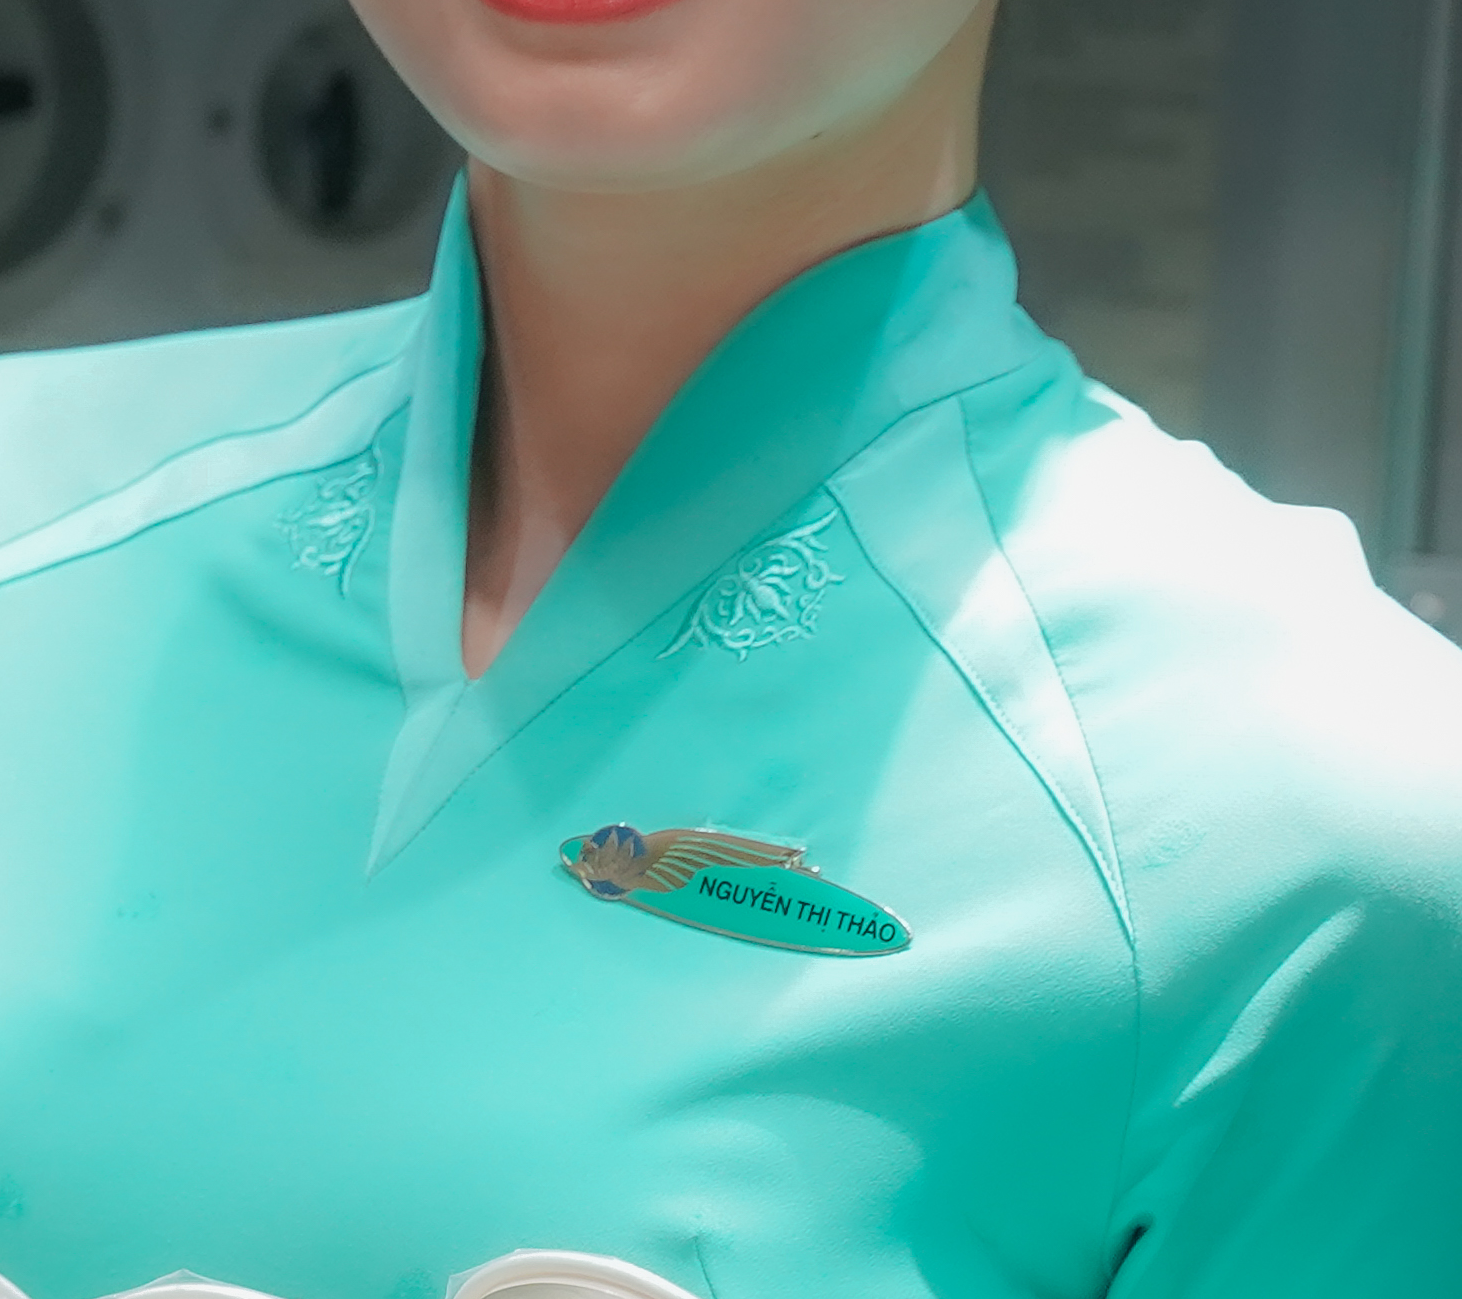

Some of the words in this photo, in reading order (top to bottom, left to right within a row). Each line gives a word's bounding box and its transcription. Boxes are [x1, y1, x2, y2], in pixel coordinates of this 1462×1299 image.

[699, 874, 792, 917] NGUYỄN
[796, 900, 832, 933] THỊ
[837, 911, 896, 944] THẢO
